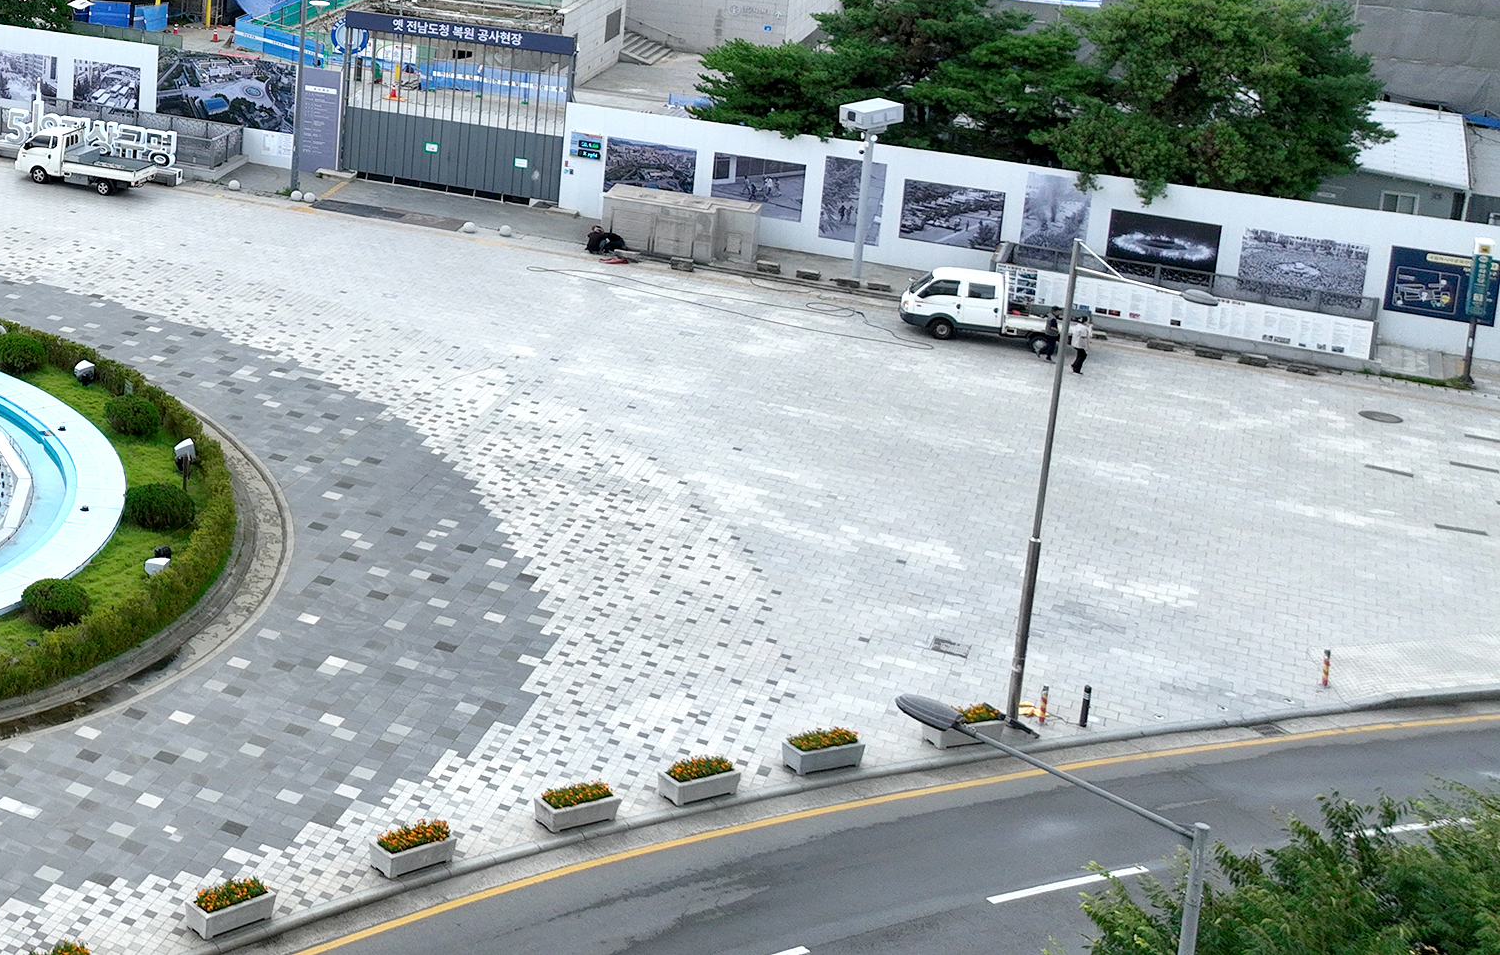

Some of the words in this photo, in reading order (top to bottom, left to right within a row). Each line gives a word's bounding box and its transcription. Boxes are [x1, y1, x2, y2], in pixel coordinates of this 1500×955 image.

[392, 18, 404, 32] 옛
[406, 20, 450, 37] 전남도청
[452, 26, 475, 40] 복원
[478, 29, 523, 46] 공사현장
